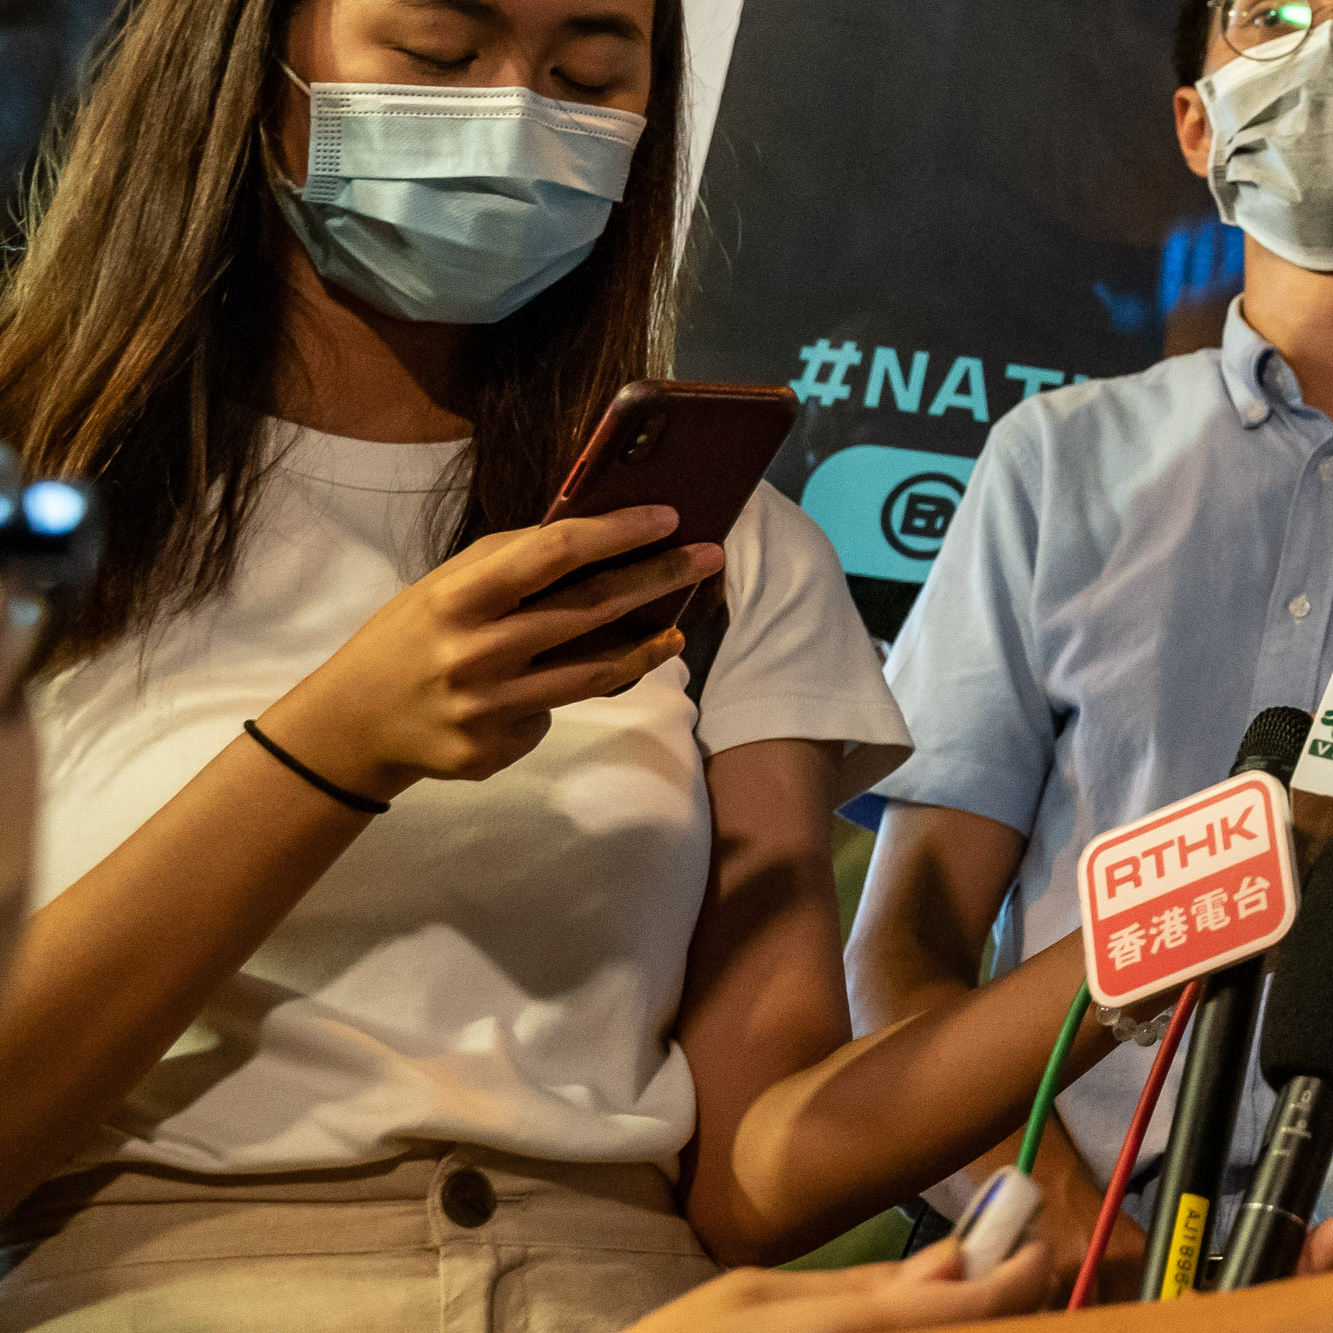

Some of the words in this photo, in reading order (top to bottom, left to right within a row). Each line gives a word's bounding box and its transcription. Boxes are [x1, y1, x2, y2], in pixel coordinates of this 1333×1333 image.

[789, 338, 1090, 423] #NAT
[1106, 804, 1258, 900] RTHK
[1107, 874, 1272, 972] 香港電台
